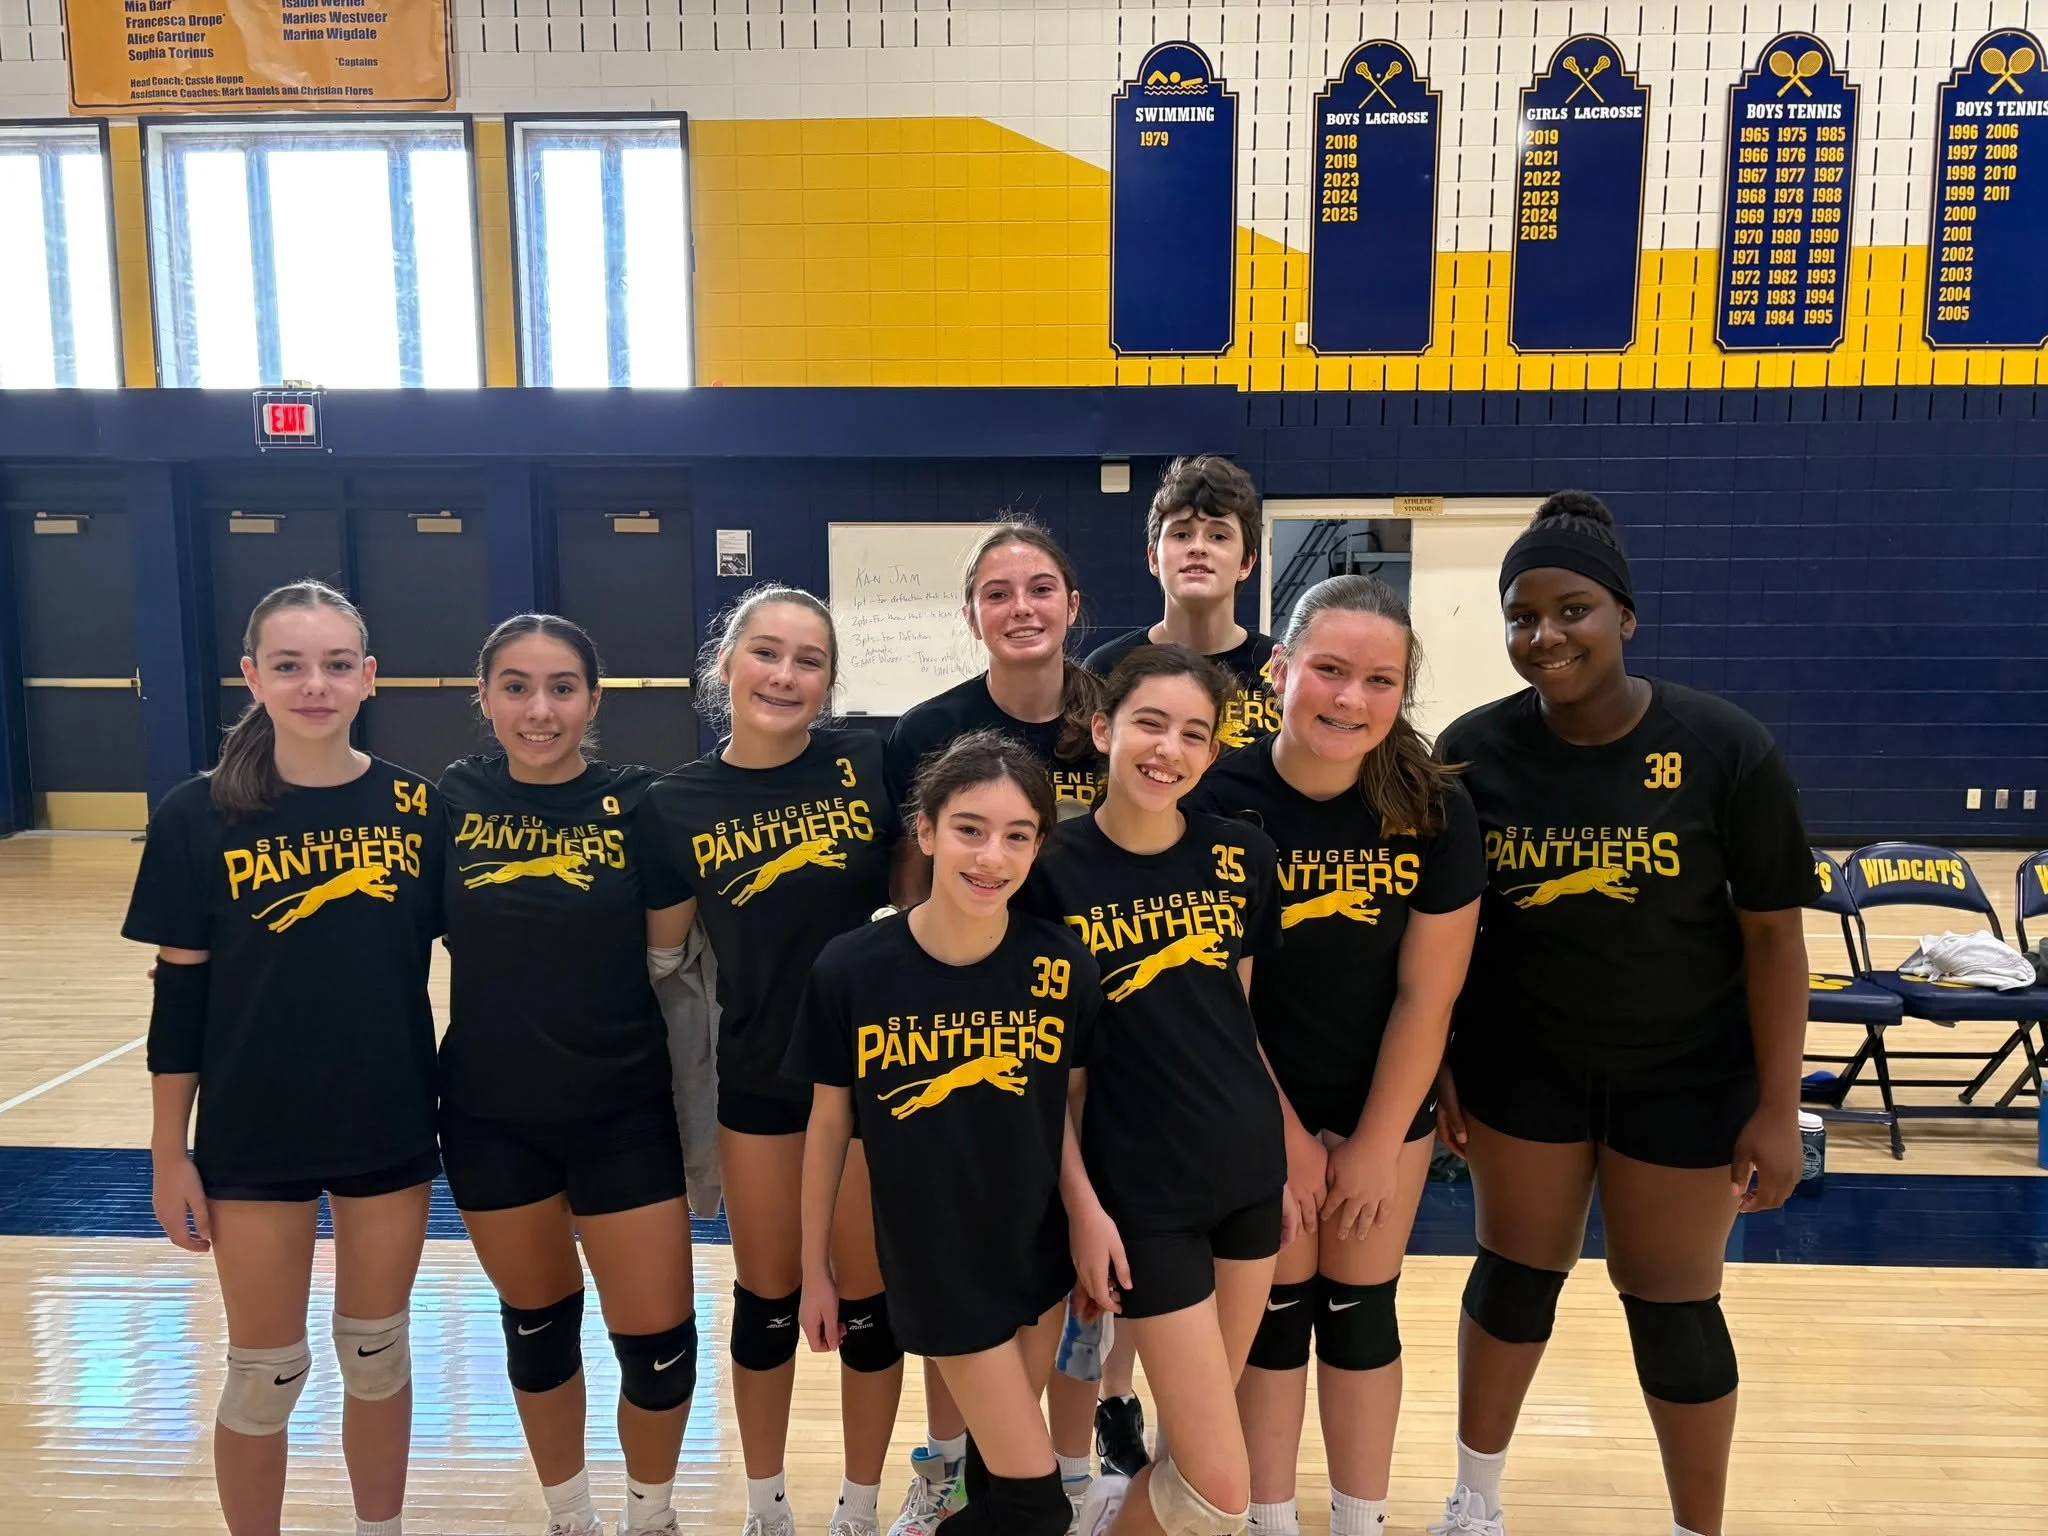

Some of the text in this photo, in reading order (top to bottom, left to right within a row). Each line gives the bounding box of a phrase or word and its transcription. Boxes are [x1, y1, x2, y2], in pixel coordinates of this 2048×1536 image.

[125, 1, 146, 12] Mia
[282, 0, 318, 8] Isabel
[126, 16, 185, 28] Francesca
[283, 12, 387, 24] Marlies Westveer
[128, 31, 205, 45] Alice Gardner
[283, 28, 376, 41] Marina Wigdale
[129, 47, 214, 61] Sophia Torinus
[131, 75, 243, 87] Head Coach: Cassie Hoppe
[131, 86, 373, 99] Assistance Coaches: Mark Daniels and Christian Flores
[1136, 107, 1214, 122] SWIMMING
[1525, 106, 1642, 122] GIRLS LACROSSE
[1747, 104, 1841, 119] BOYS TENNIS
[1956, 101, 2048, 116] BOYS TENNIS
[1326, 112, 1428, 125] BOYS LACROSSE
[1141, 132, 1168, 146] 1979
[1523, 127, 1558, 148] 2019
[1741, 127, 1845, 142] 1965 1975 1985
[1949, 124, 2018, 139] 1996 2006
[1326, 134, 1357, 149] 2018
[1522, 149, 1557, 165] 2021
[1739, 147, 1844, 162] 1966 1976 1986
[1948, 144, 2017, 160] 1997 2008
[1325, 154, 1357, 168] 2019
[1324, 172, 1359, 187] 2023
[1524, 171, 1560, 186] 2022
[1738, 167, 1843, 183] 1967 1977 1987
[1947, 165, 2016, 180] 1998 2010
[1323, 189, 1357, 204] 2024
[1523, 191, 1558, 206] 2023
[1737, 188, 1842, 203] 1968 1978 1988
[1945, 186, 2009, 200] 1999 2011
[1322, 207, 1357, 222] 2025
[1522, 208, 1557, 223] 2024
[1736, 208, 1840, 223] 1969 1979 1989
[1944, 206, 1976, 221] 2000
[1521, 225, 1557, 240] 2025
[1734, 229, 1839, 244] 1970 1980 1990
[1943, 227, 1971, 241] 2001
[1733, 249, 1834, 264] 1971 1981 1991
[1942, 247, 1973, 261] 2002
[1731, 269, 1836, 285] 1972 1982 1993
[1940, 267, 1972, 281] 2003
[1730, 289, 1834, 305] 1973 1983 1994
[1939, 287, 1970, 301] 2004
[1728, 309, 1832, 325] 1974 1984 1995
[1938, 306, 1969, 320] 2005
[836, 758, 856, 787] 3
[1054, 772, 1094, 784] ENE
[1644, 752, 1682, 789] 38
[394, 780, 427, 816] 54
[602, 796, 620, 815] 9
[715, 798, 844, 835] ST. EUGENE
[487, 815, 600, 839] ST. EUENE
[1506, 826, 1648, 840] ST. EUGENE
[256, 826, 401, 852] ST. EUGENE
[455, 812, 626, 869] PANTHERS
[692, 800, 873, 878] PANTHERS
[1292, 848, 1390, 862] EUGENE
[1485, 830, 1680, 876] PANTHERS
[224, 833, 422, 900] PANTHERS
[1211, 844, 1246, 883] 35
[1277, 853, 1419, 896] NTHERS
[1859, 858, 1966, 890] WILDCATS
[1091, 889, 1230, 920] ST. EUGENE
[1030, 956, 1071, 1000] 39
[888, 1009, 1037, 1031] ST. EUGENE
[858, 1016, 1064, 1079] PANTHERS
